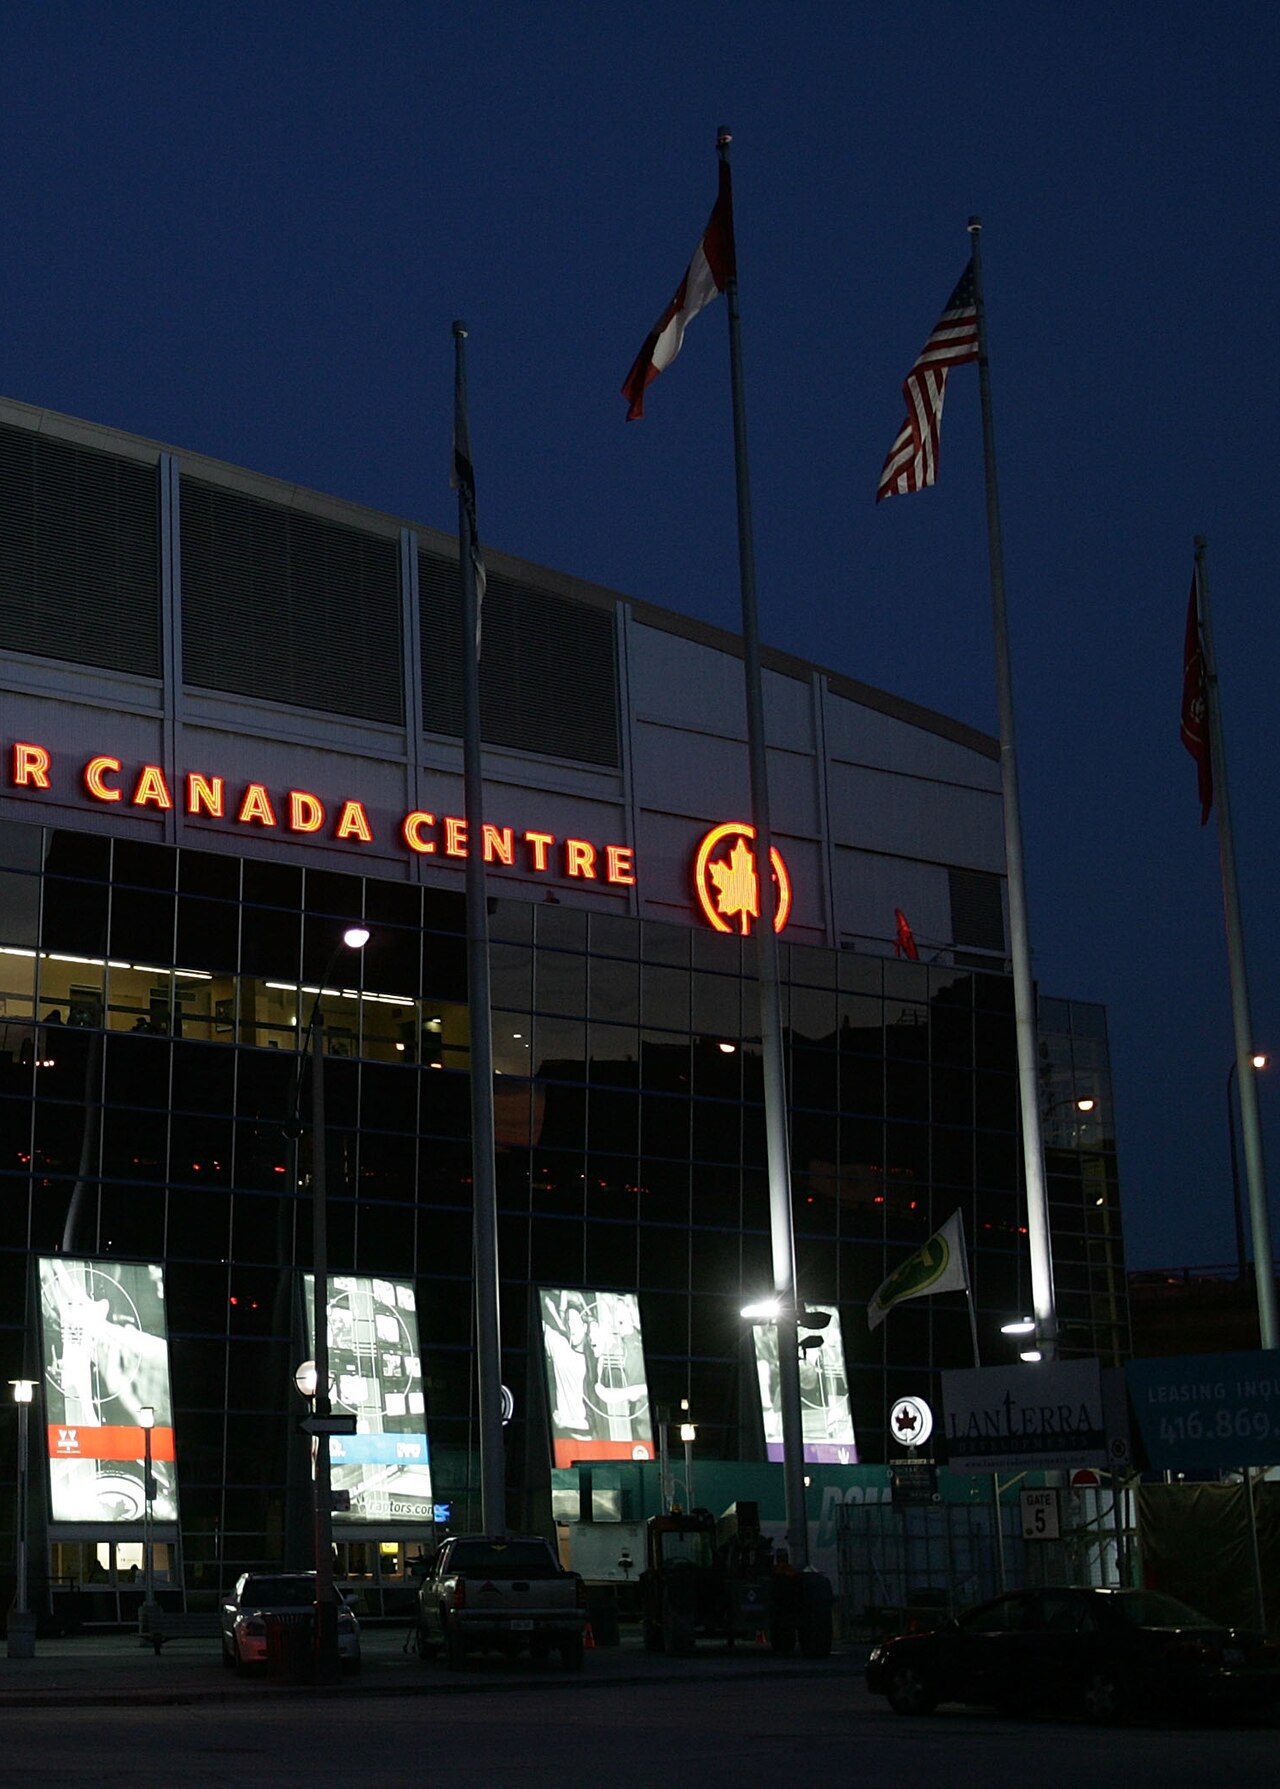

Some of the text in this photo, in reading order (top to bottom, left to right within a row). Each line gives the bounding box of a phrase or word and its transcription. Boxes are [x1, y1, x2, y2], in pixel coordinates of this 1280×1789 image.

[85, 756, 372, 841] CANADA
[404, 811, 635, 884] CENTRE
[1148, 1382, 1226, 1403] LEASING
[1026, 1497, 1052, 1506] GATE
[1035, 1508, 1046, 1533] 5
